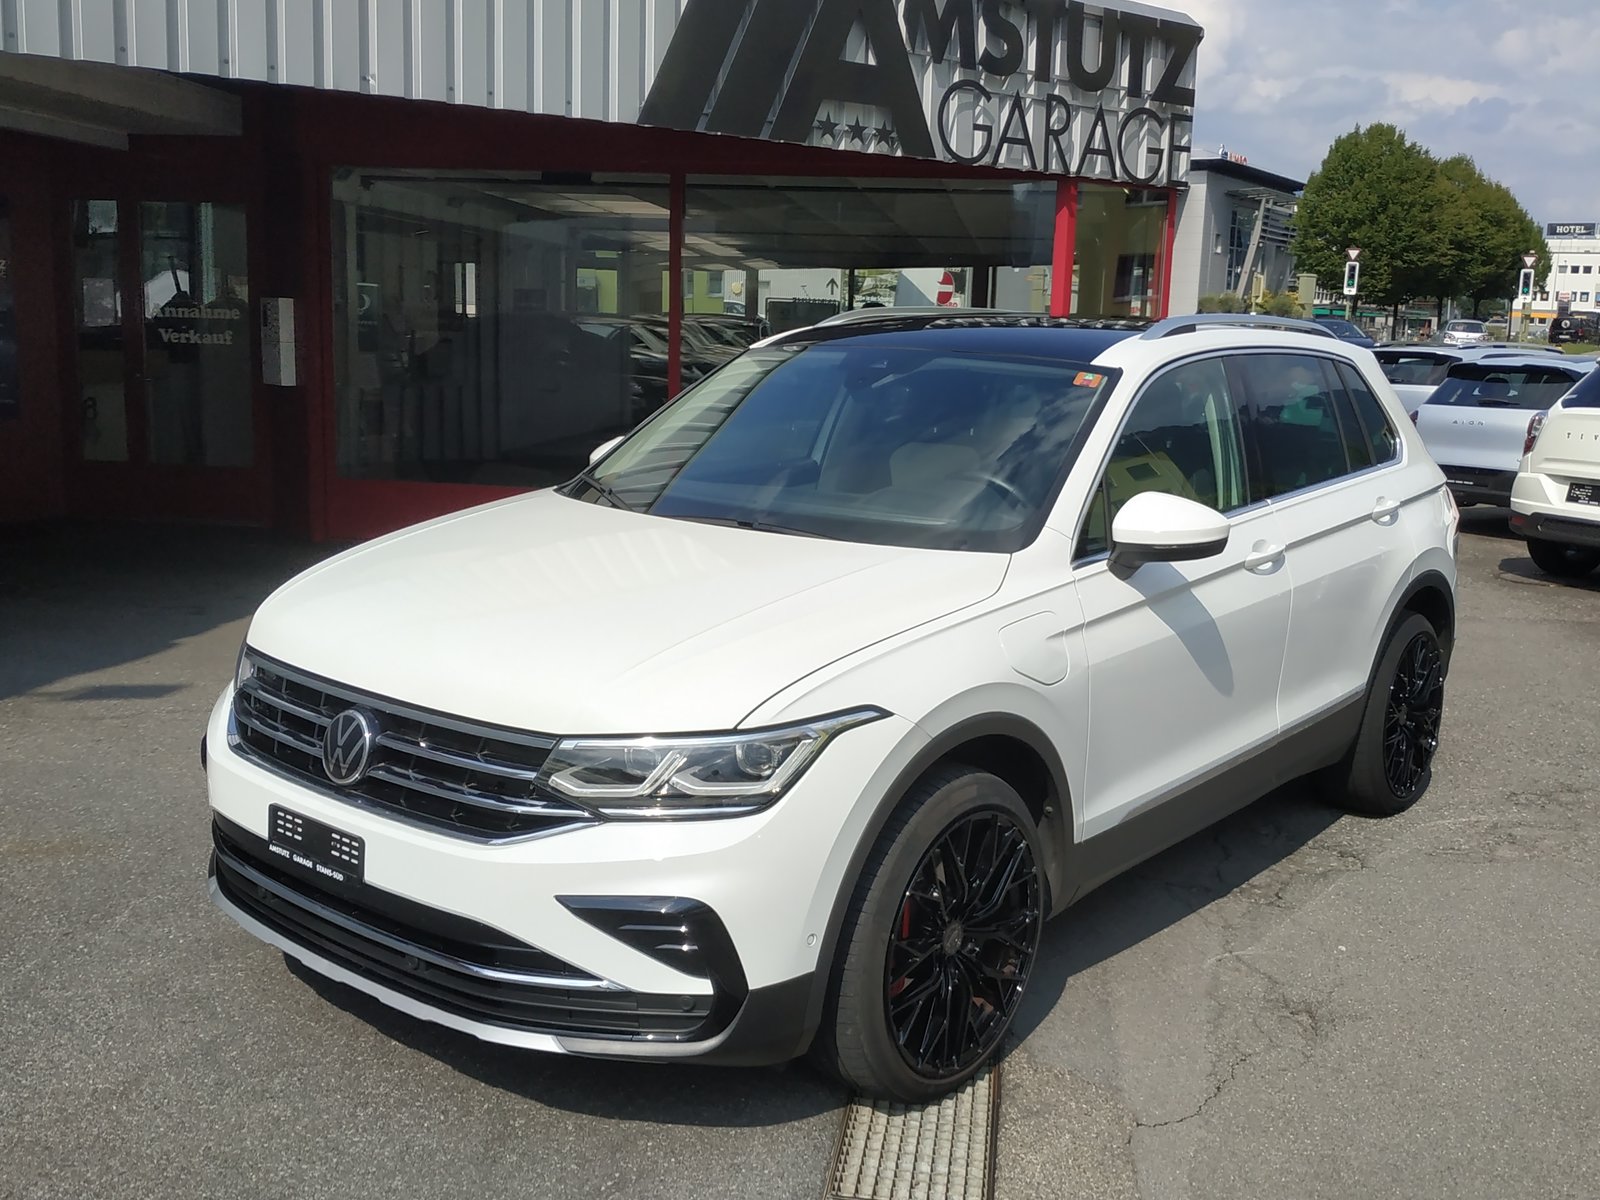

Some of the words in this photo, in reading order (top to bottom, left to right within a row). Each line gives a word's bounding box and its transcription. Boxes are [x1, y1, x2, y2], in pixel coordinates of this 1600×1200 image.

[768, 0, 1205, 158] AMSTUTZ
[937, 79, 1194, 188] GARAGE
[1556, 225, 1586, 234] HOTEL
[152, 303, 240, 319] Annahme
[157, 327, 233, 345] Verkauf
[268, 843, 291, 859] AMSTUTZ
[292, 854, 313, 869] GARAGE
